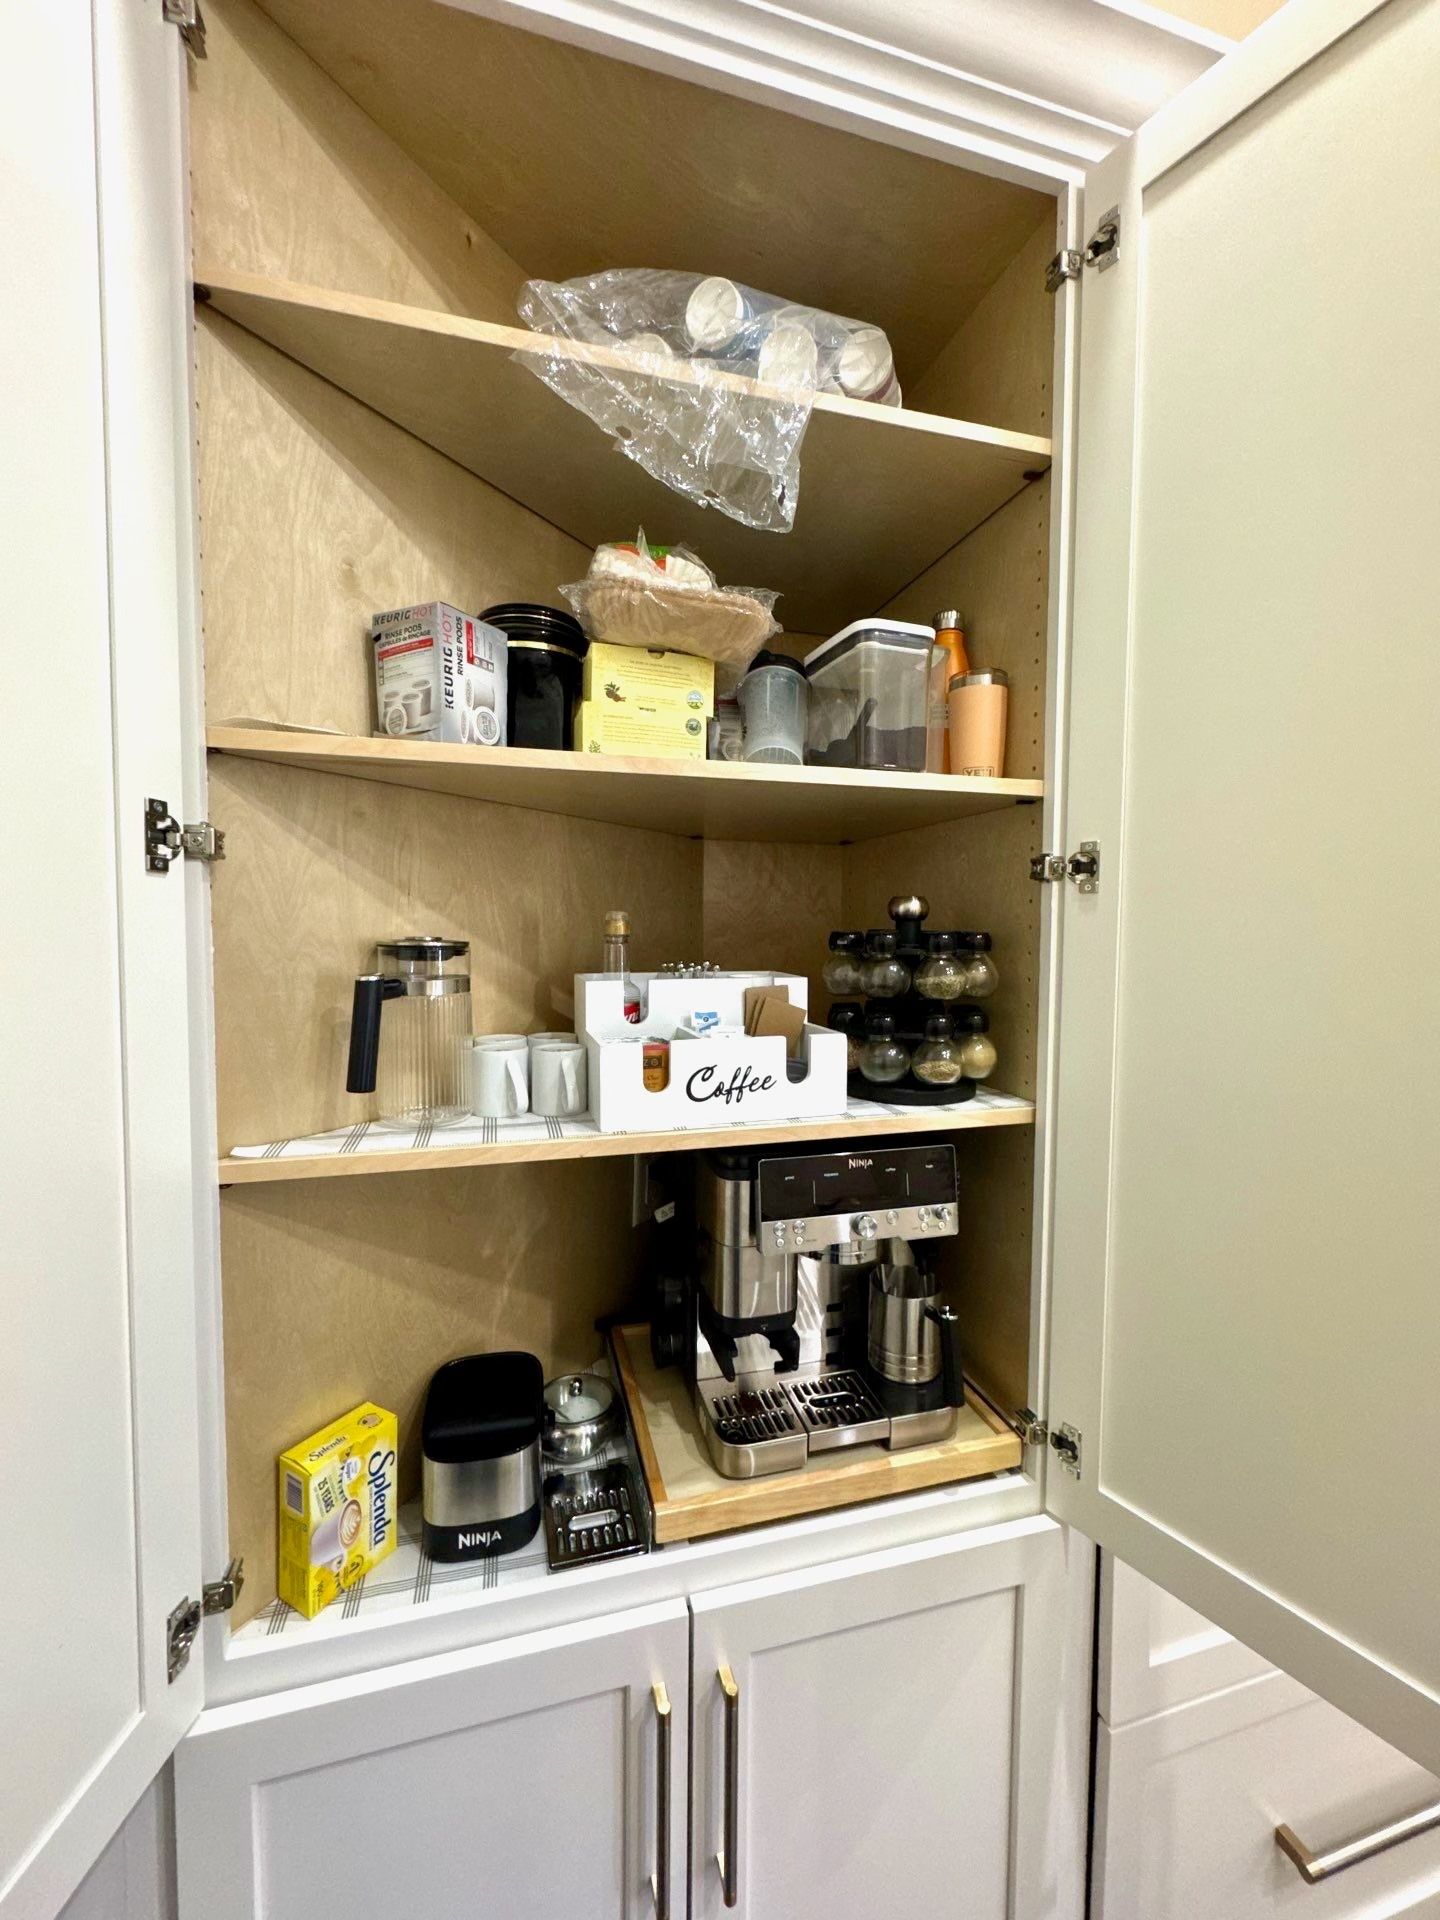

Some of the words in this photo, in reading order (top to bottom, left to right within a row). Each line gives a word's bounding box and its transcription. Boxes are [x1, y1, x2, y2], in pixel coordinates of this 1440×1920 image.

[374, 610, 411, 626] KEURIG
[412, 605, 433, 618] HOT
[442, 612, 452, 645] HOT
[385, 628, 403, 639] RINSE
[404, 623, 422, 635] PODS
[456, 646, 464, 676] RINSE
[443, 646, 454, 710] KEURIG
[686, 1064, 777, 1105] Coffee
[848, 1158, 873, 1170] NINJA
[308, 1435, 347, 1461] Splenda
[367, 1450, 395, 1546] Splenda
[458, 1530, 502, 1549] NINJA
